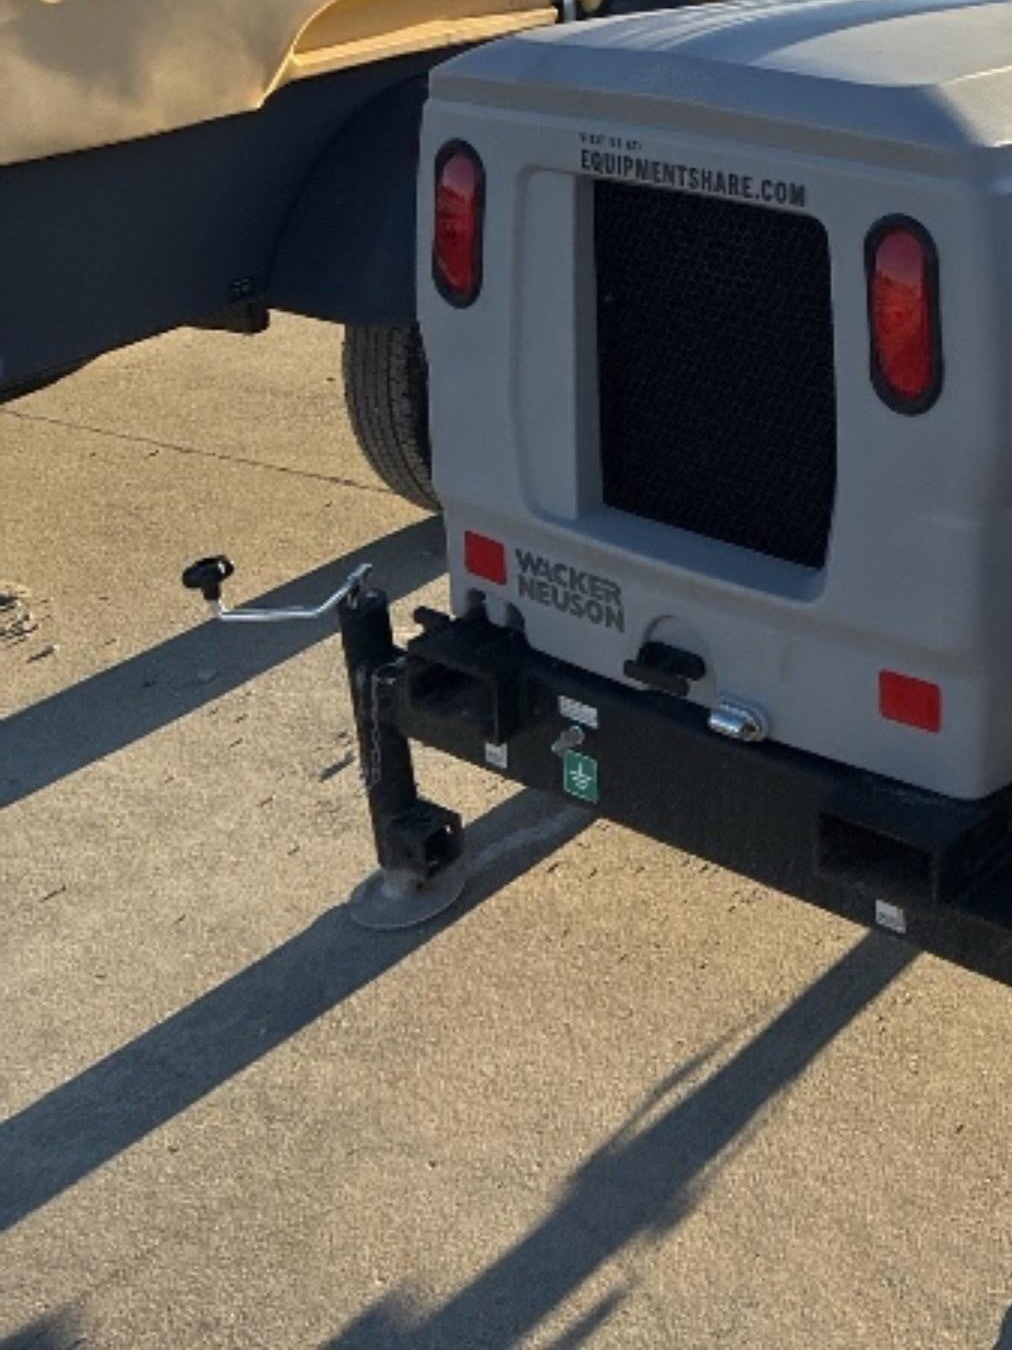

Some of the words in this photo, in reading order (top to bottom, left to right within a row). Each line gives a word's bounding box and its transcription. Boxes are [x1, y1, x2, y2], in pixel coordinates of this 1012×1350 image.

[580, 149, 806, 208] EQUIPMENTSHARE.COM
[515, 548, 622, 608] WACKER
[518, 572, 625, 634] NEUSON
